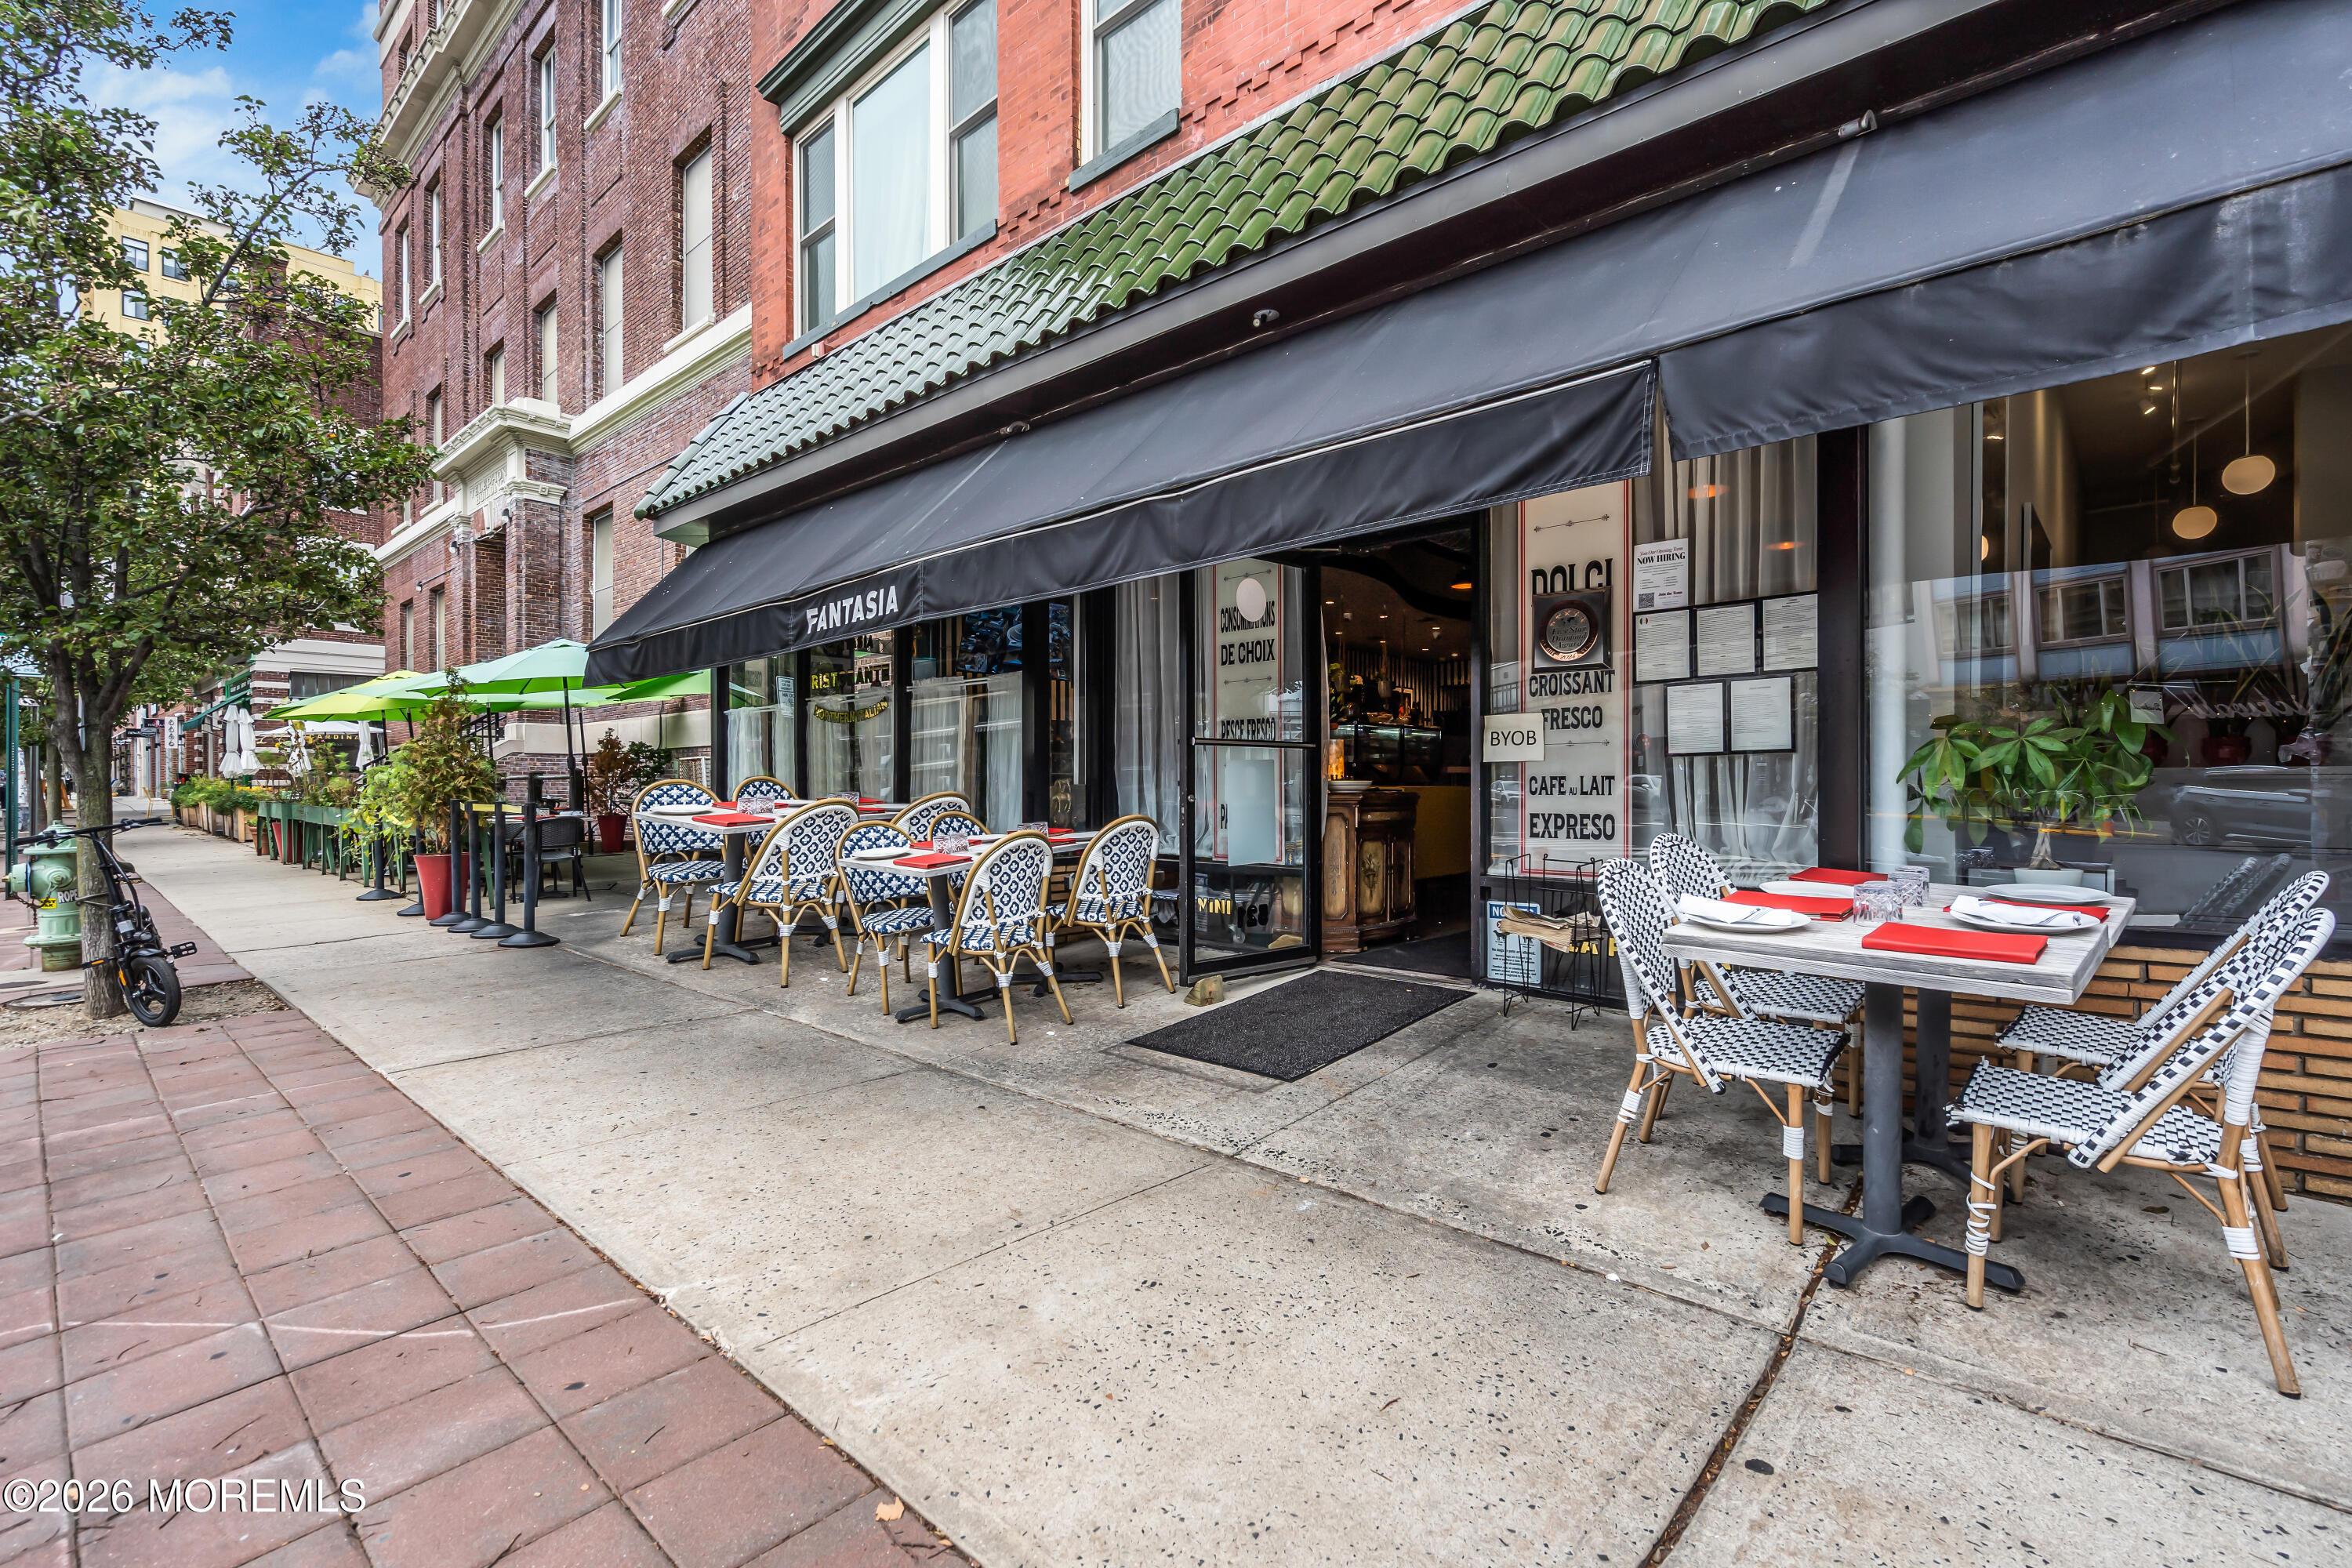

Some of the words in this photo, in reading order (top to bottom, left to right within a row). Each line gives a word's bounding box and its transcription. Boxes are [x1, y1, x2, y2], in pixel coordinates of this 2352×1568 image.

[470, 465, 507, 499] TELEPHON
[1637, 556, 1655, 565] NOW
[1657, 551, 1686, 562] HIRING
[1531, 558, 1613, 595] DOLCI
[806, 585, 898, 634] FANTASIA
[1221, 644, 1235, 666] DE
[1238, 639, 1275, 663] CHOIX
[1529, 670, 1615, 697] CROISSANT
[1247, 717, 1276, 741] FRESCO
[1541, 706, 1603, 730] FRESCO
[1490, 730, 1537, 746] BYOB
[1529, 775, 1566, 796] CAFE
[1569, 786, 1577, 796] AU
[1580, 775, 1615, 796] LAIT
[1529, 813, 1616, 840] EXPRESO
